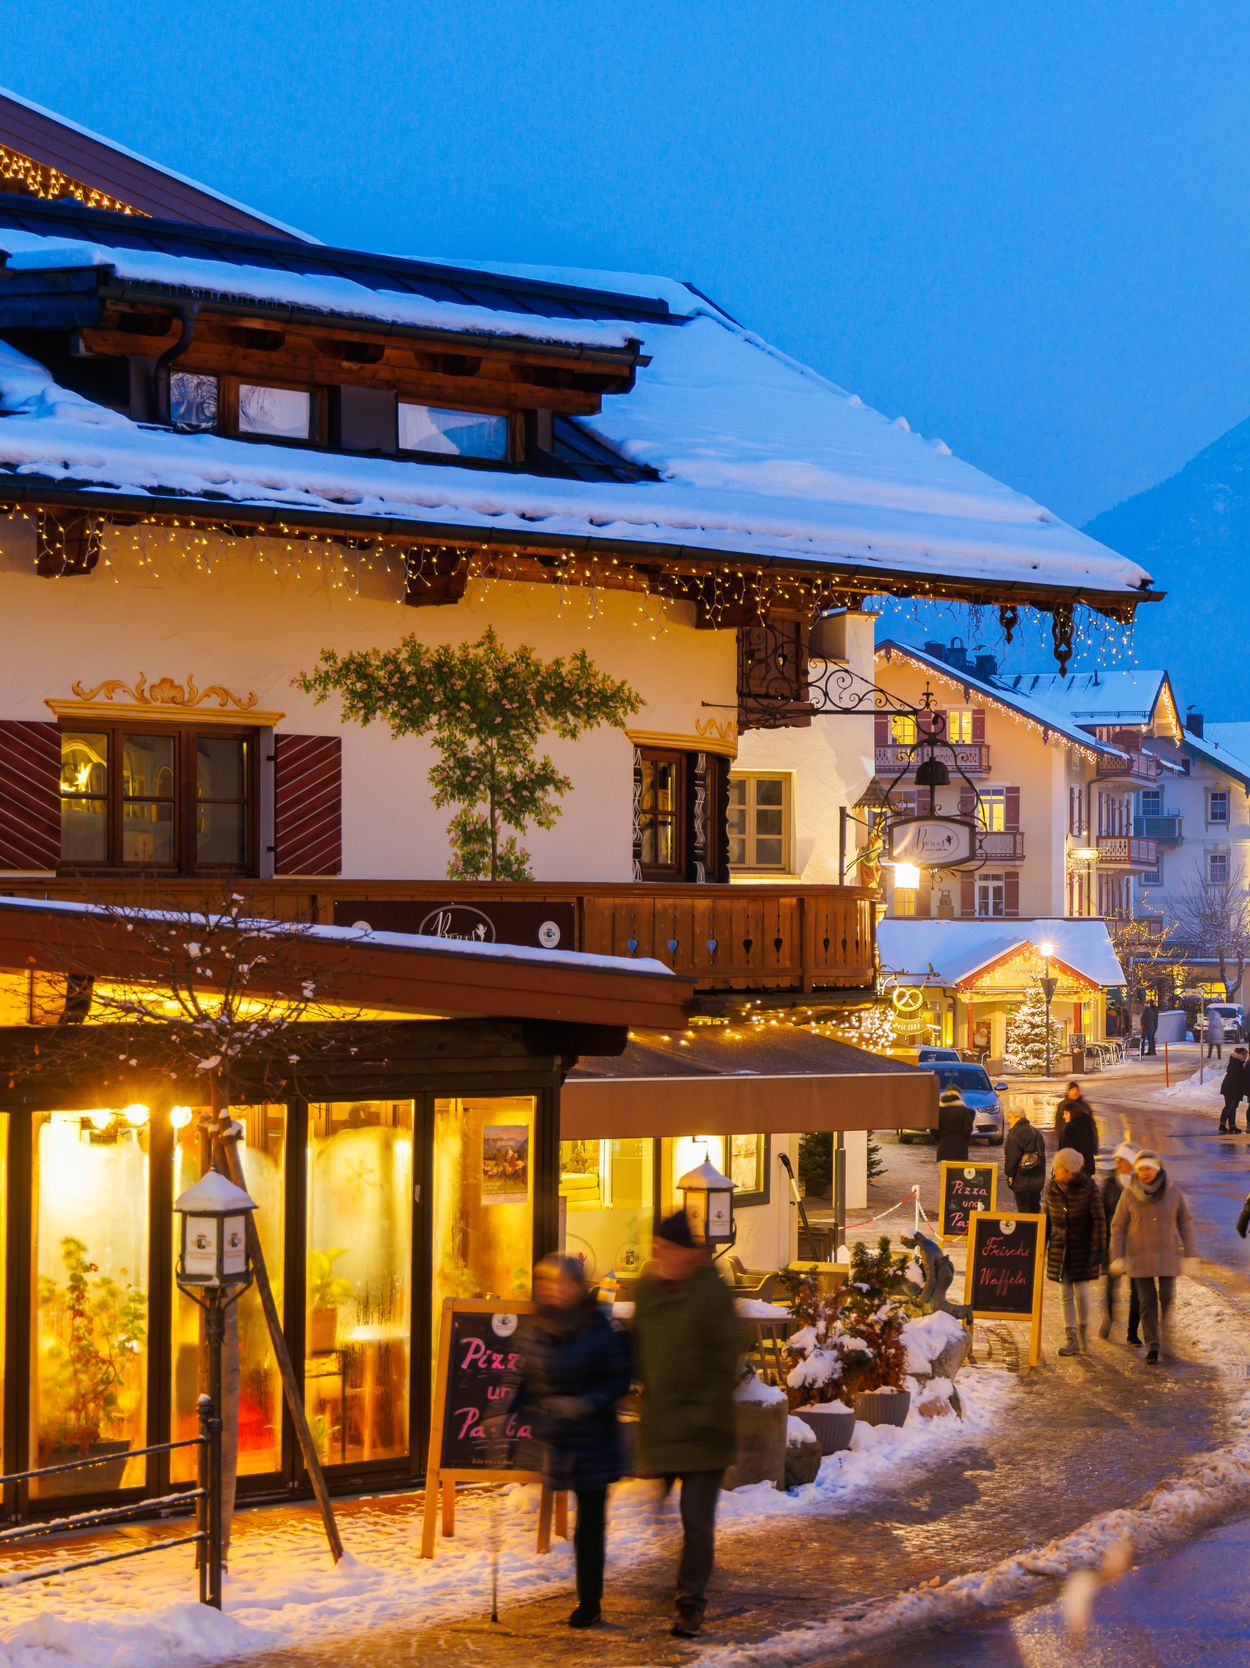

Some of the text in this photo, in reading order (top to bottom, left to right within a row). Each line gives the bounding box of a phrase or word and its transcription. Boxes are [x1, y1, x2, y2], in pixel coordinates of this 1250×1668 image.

[952, 1180, 988, 1196] Pizza
[981, 1236, 1030, 1257] Frische
[979, 1266, 1028, 1296] Waffeln
[460, 1337, 521, 1370] Pizz
[487, 1385, 514, 1401] un
[454, 1407, 533, 1440] Pasta
